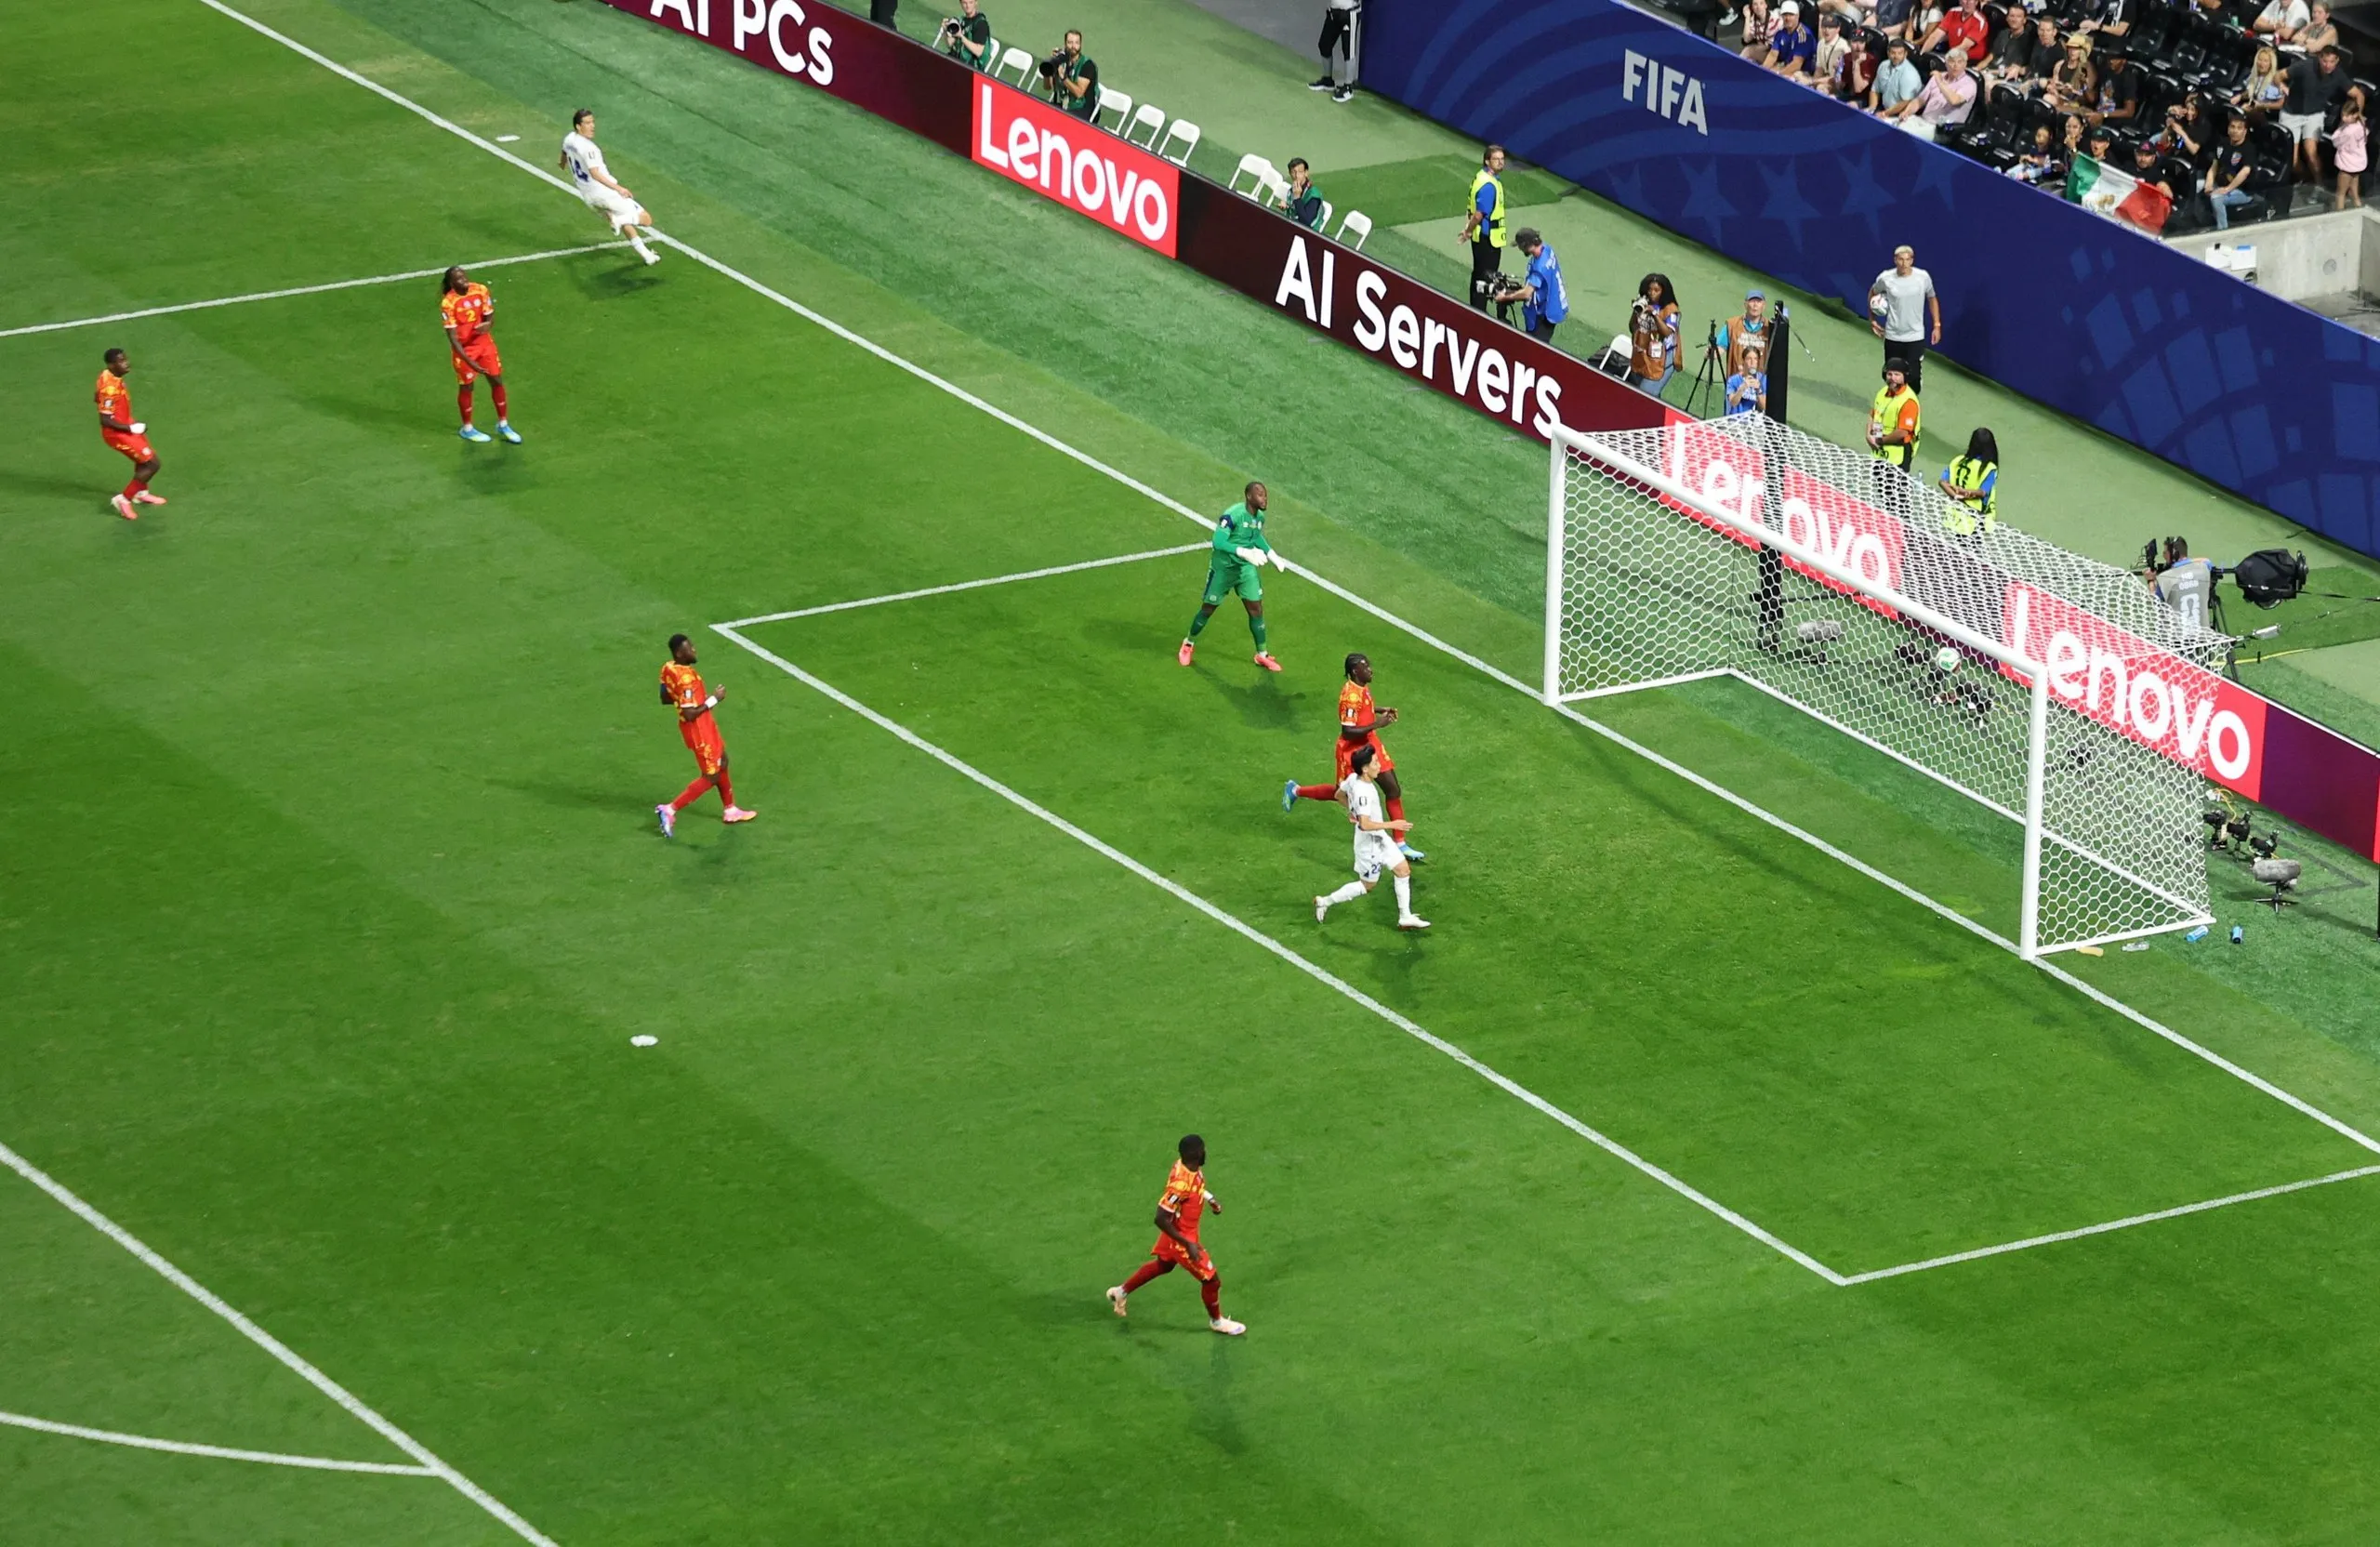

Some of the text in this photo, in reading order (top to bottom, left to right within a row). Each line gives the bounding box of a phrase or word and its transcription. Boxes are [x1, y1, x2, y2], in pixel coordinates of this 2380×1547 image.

[734, 0, 834, 86] PCs
[1623, 48, 1708, 136] FIFA
[981, 85, 1168, 241] Lenovo
[465, 310, 476, 323] 2
[1276, 235, 1562, 439] AI Servers
[2011, 588, 2251, 780] Lenovo
